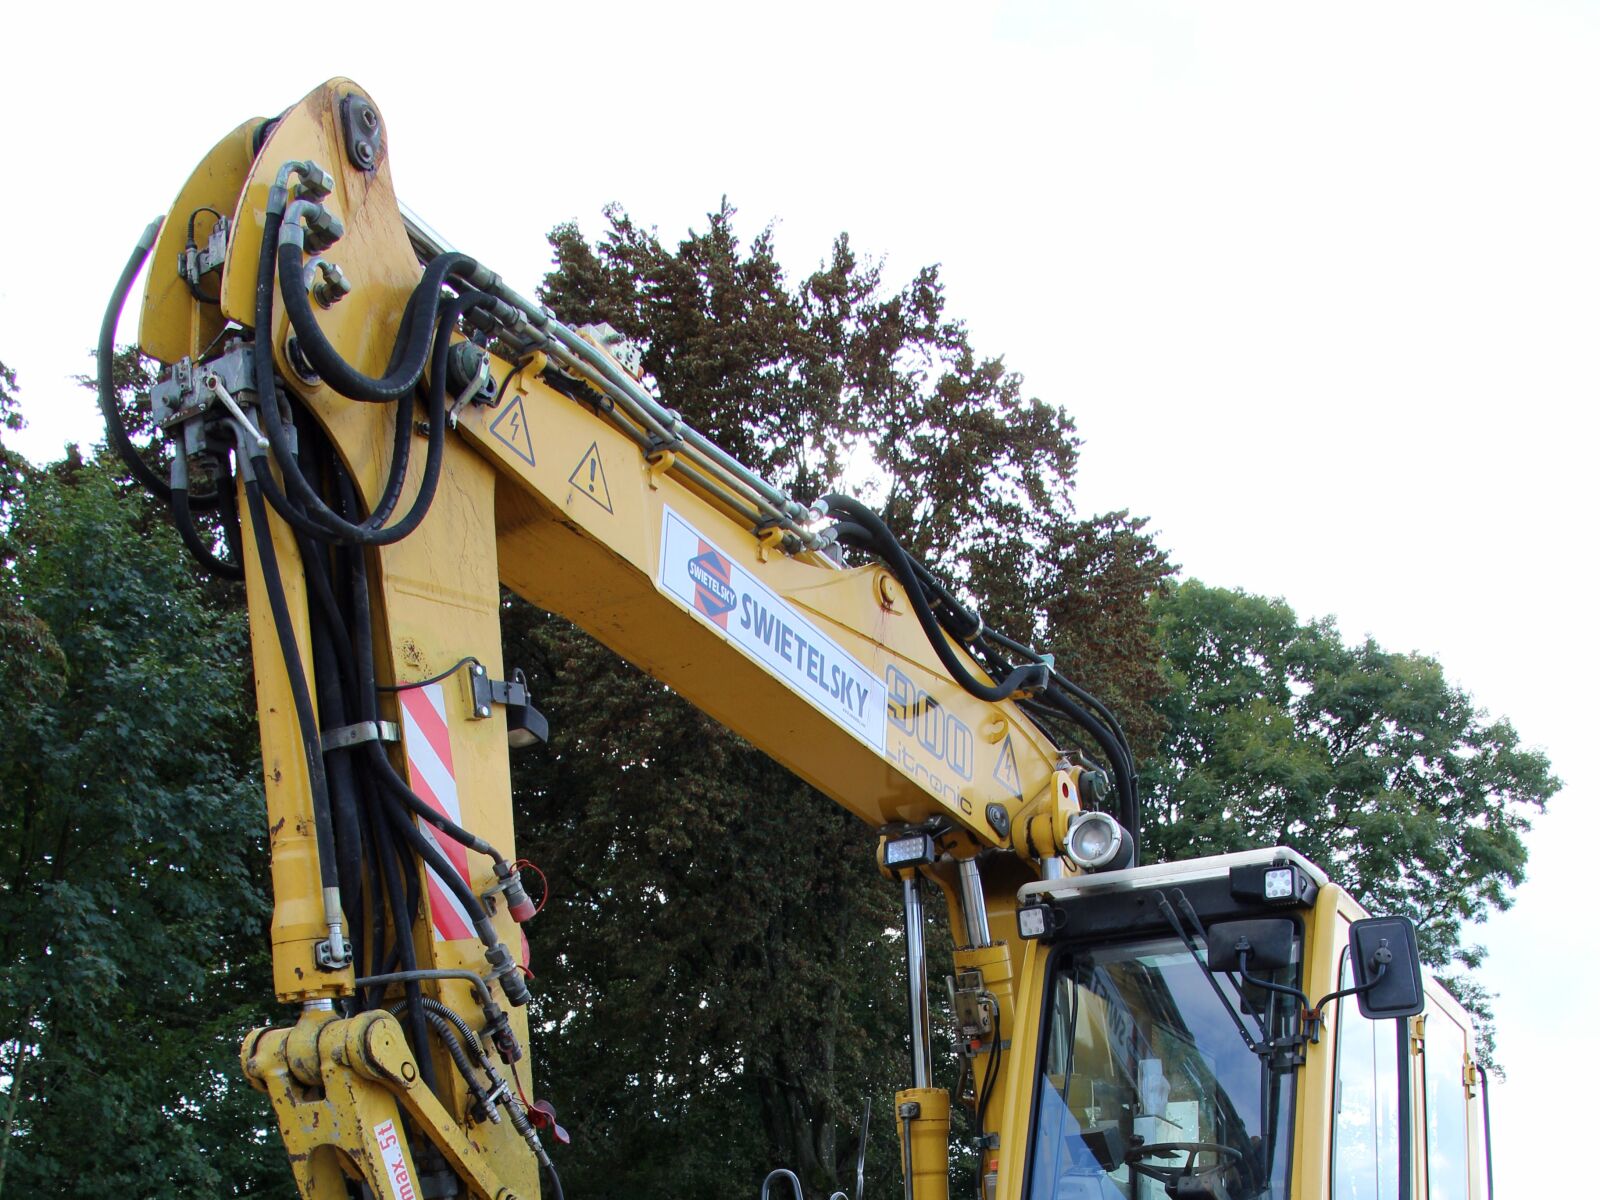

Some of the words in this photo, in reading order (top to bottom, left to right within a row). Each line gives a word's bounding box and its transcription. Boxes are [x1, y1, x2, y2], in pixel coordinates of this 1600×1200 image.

[689, 561, 735, 605] SWIETELSKY
[740, 592, 868, 718] SWIETELSKY
[886, 664, 973, 781] 900
[378, 1123, 397, 1150] 5t
